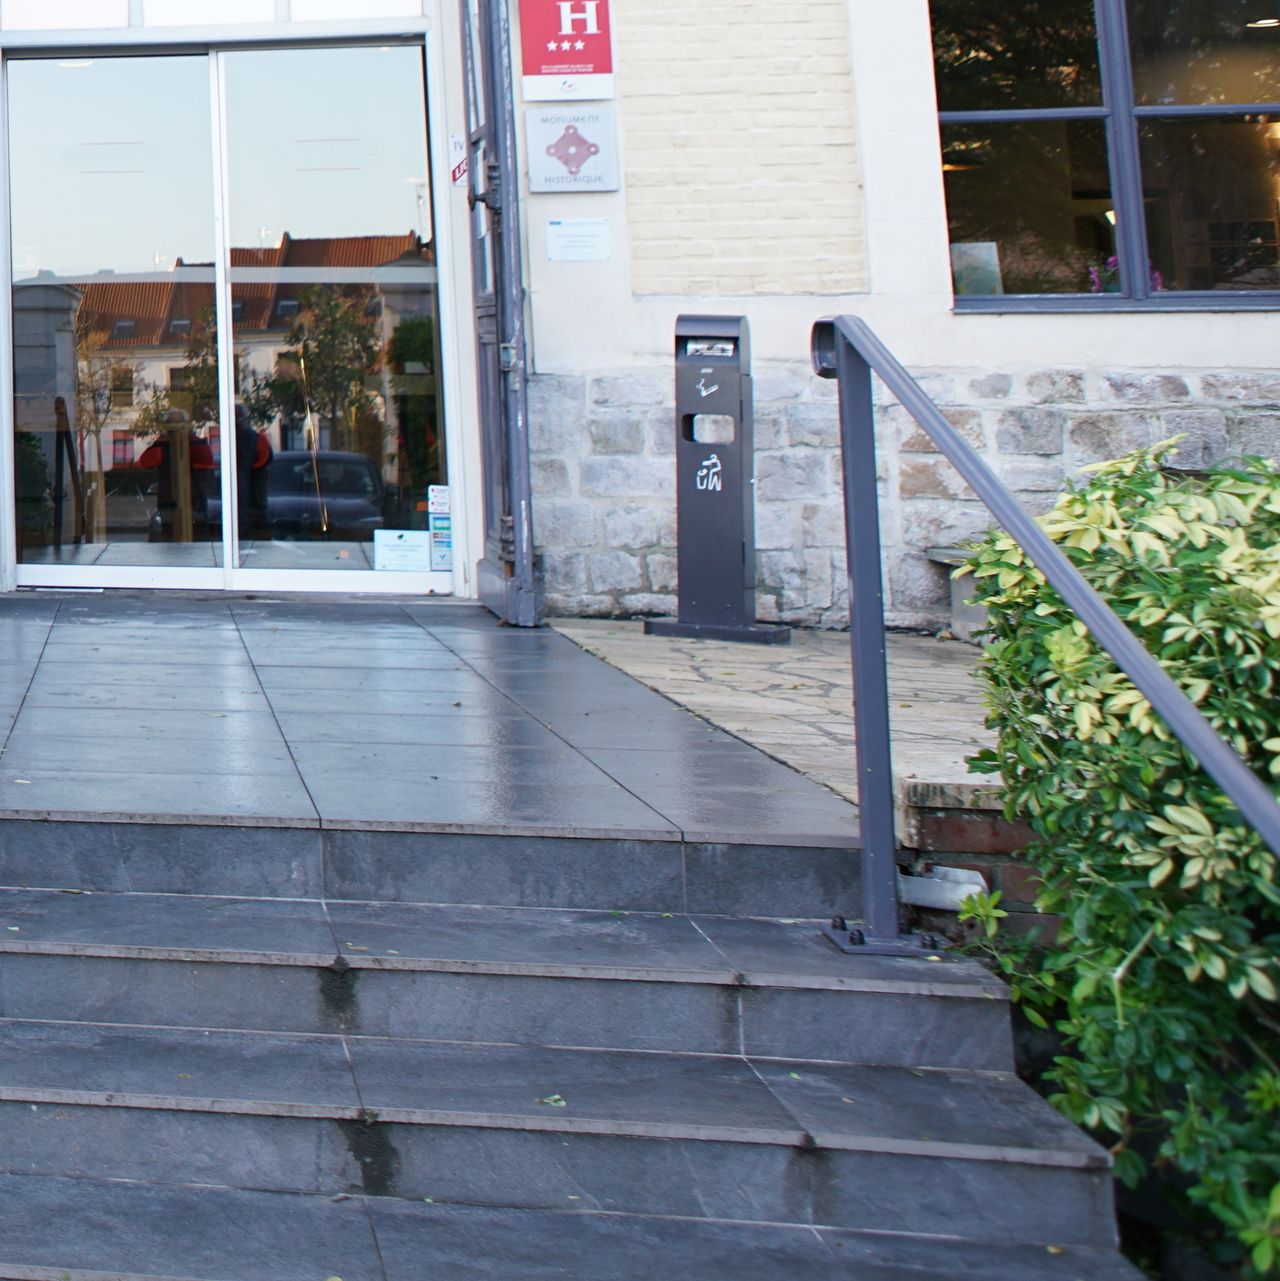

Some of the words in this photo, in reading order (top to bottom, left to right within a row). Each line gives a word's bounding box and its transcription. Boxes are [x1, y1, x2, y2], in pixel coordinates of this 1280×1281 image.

[556, 0, 602, 35] H
[541, 115, 599, 124] MONUMENT
[544, 175, 605, 184] HISTORIQUE
